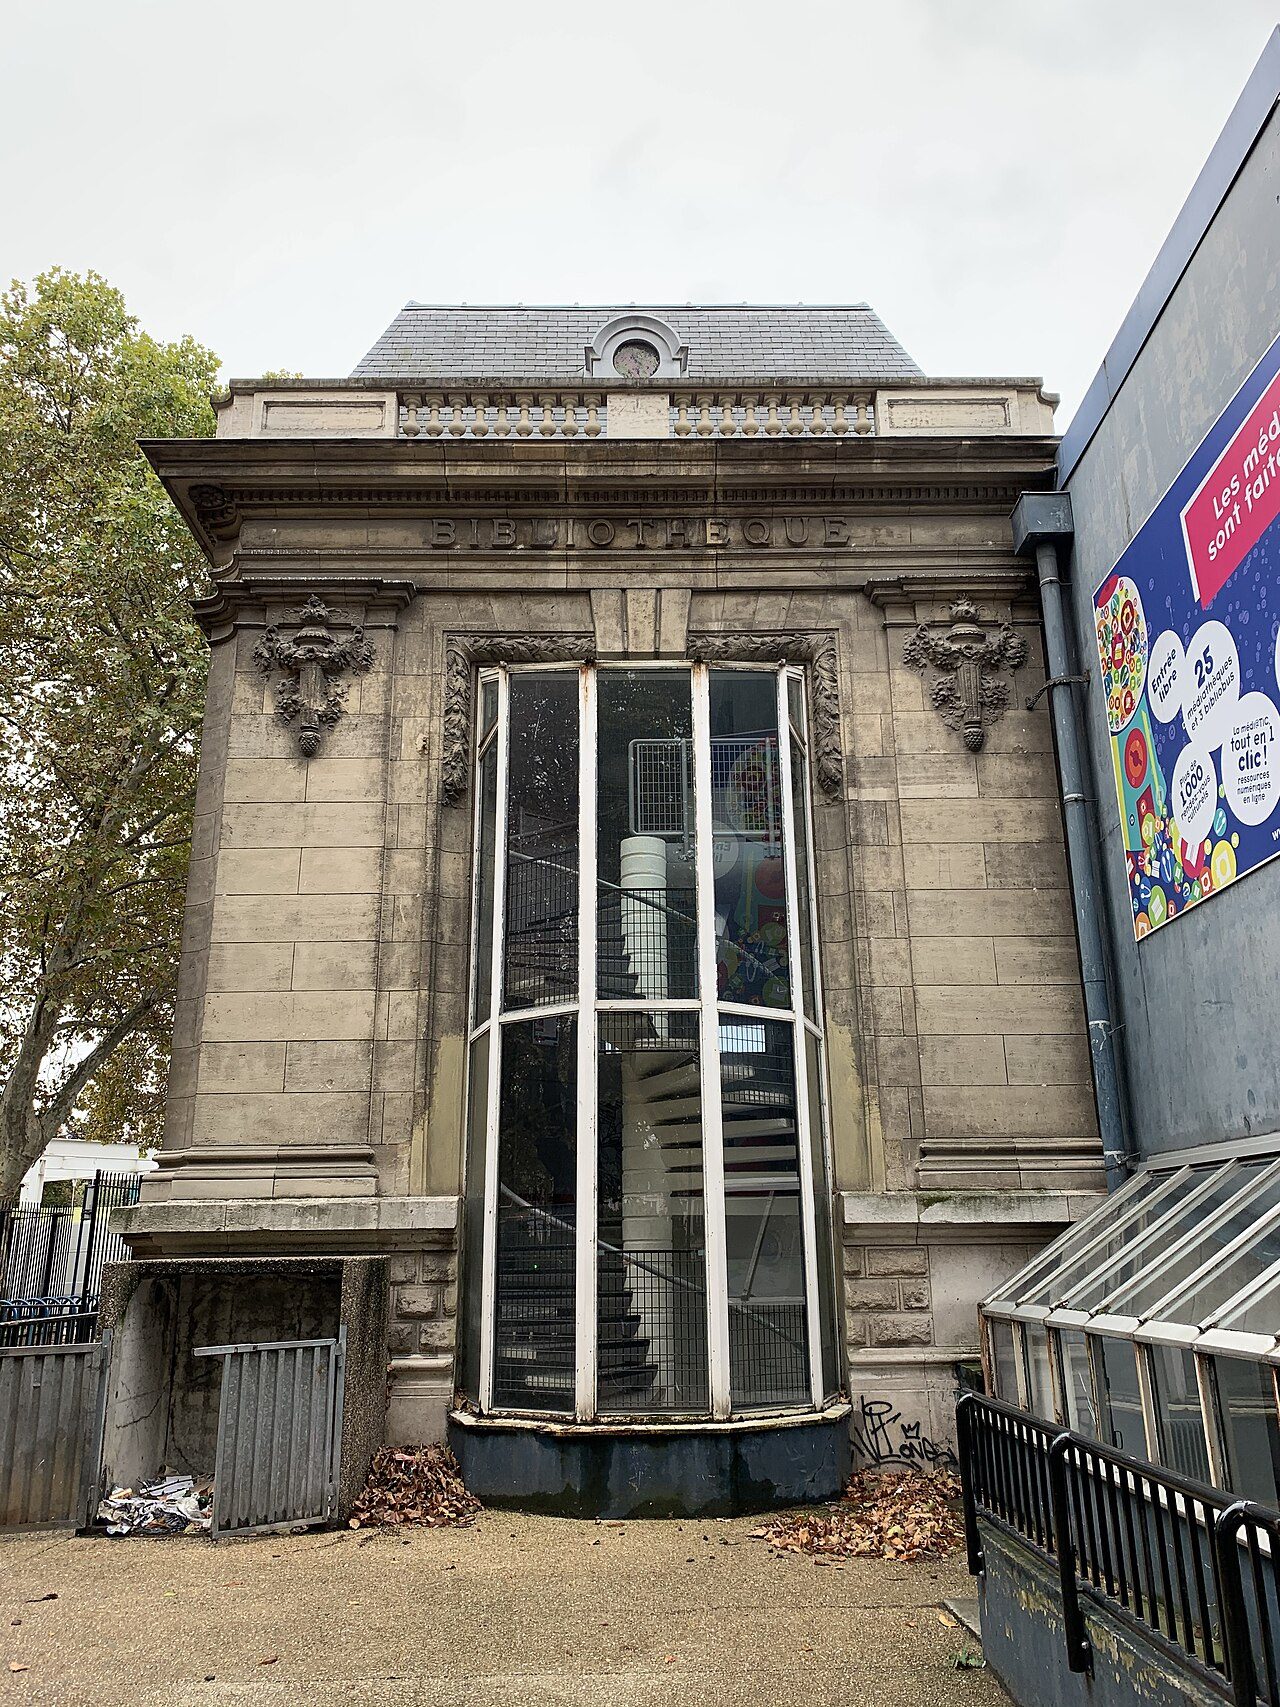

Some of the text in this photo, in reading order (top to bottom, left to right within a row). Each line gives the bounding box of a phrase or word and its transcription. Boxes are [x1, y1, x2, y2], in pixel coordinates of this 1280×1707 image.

[1213, 405, 1280, 519] Les méd
[431, 517, 852, 549] BIBLIOTHEQUE
[1207, 501, 1242, 561] sont
[1151, 649, 1176, 694] Entrée
[1194, 645, 1214, 689] 25
[1158, 669, 1177, 703] libre
[1187, 656, 1233, 720] médiathèques
[1191, 671, 1235, 731] et 3 bibliobus
[1230, 725, 1275, 752] tout en 1
[1232, 726, 1240, 736] La
[1179, 759, 1197, 788] Plus de
[1237, 771, 1270, 785] ressources
[1237, 781, 1272, 795] numériques
[1181, 774, 1211, 821] rendez-vous
[1187, 790, 1209, 824] culturels
[1243, 792, 1266, 805] en ligne
